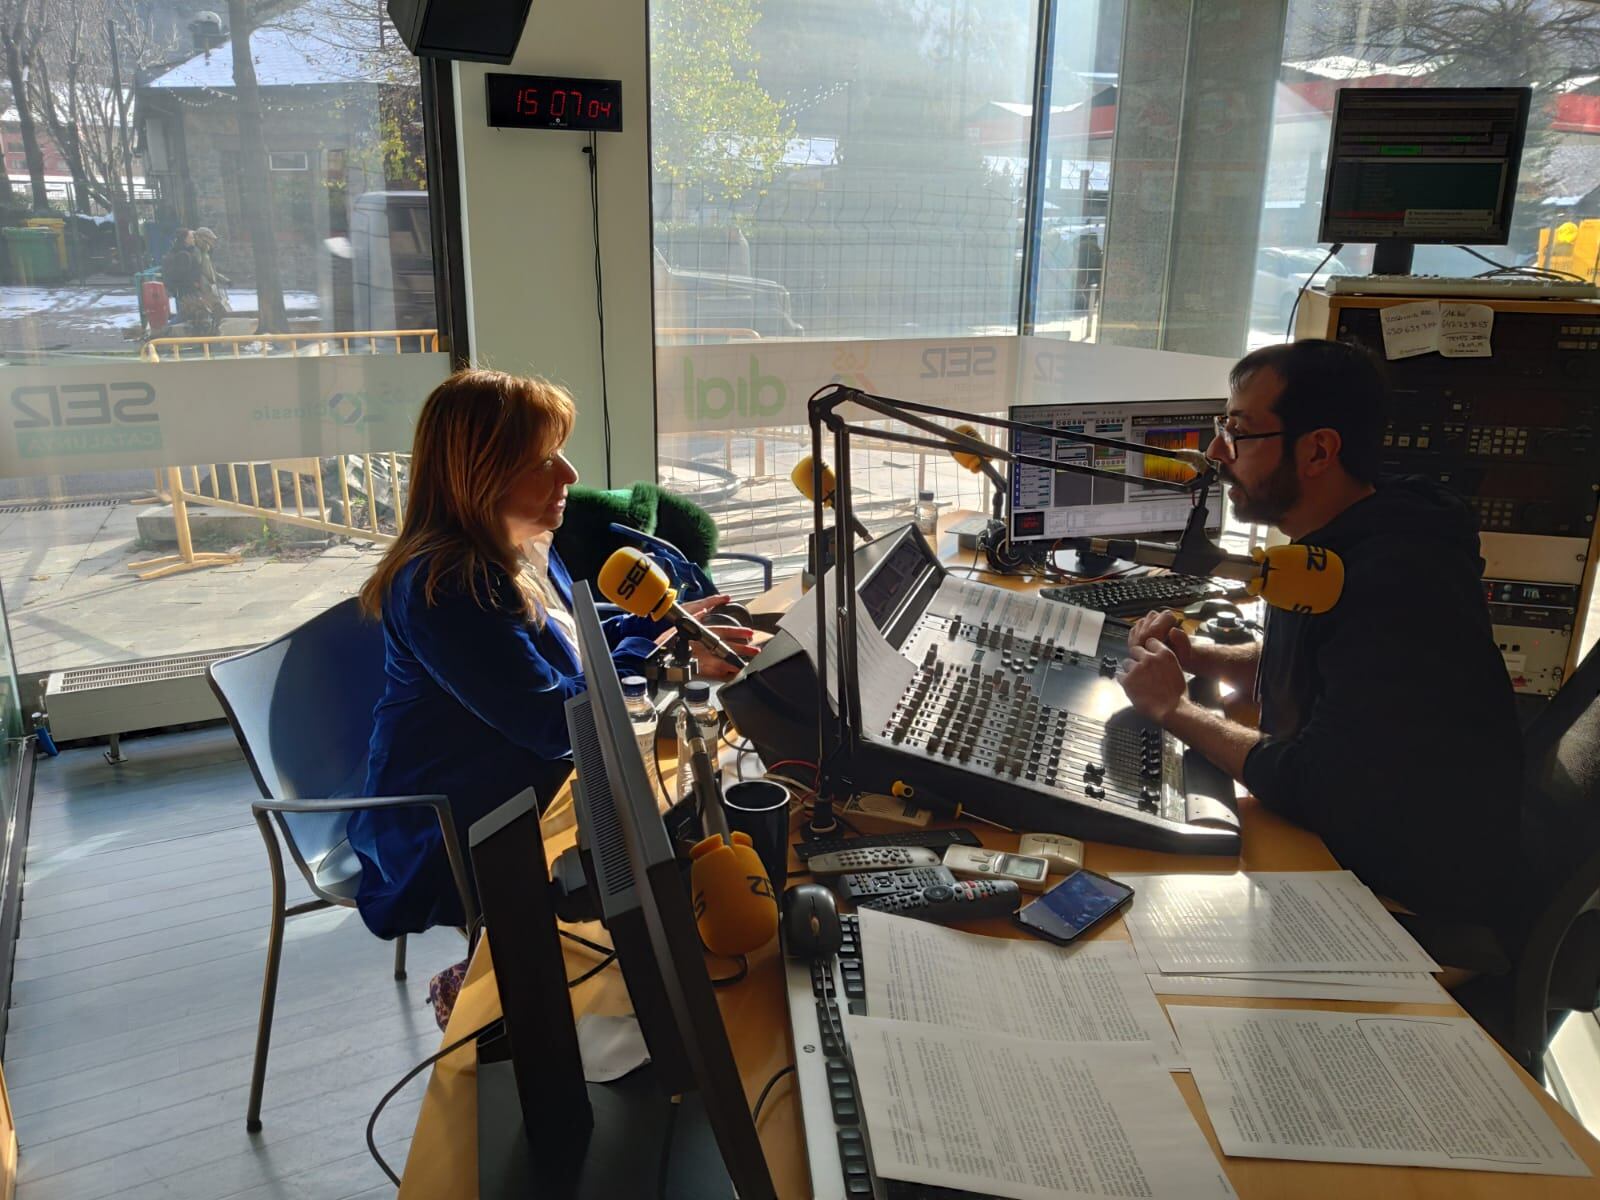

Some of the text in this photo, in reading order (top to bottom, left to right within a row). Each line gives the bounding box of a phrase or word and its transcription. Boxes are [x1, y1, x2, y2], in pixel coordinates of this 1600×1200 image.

[517, 88, 612, 119] 15 07 04
